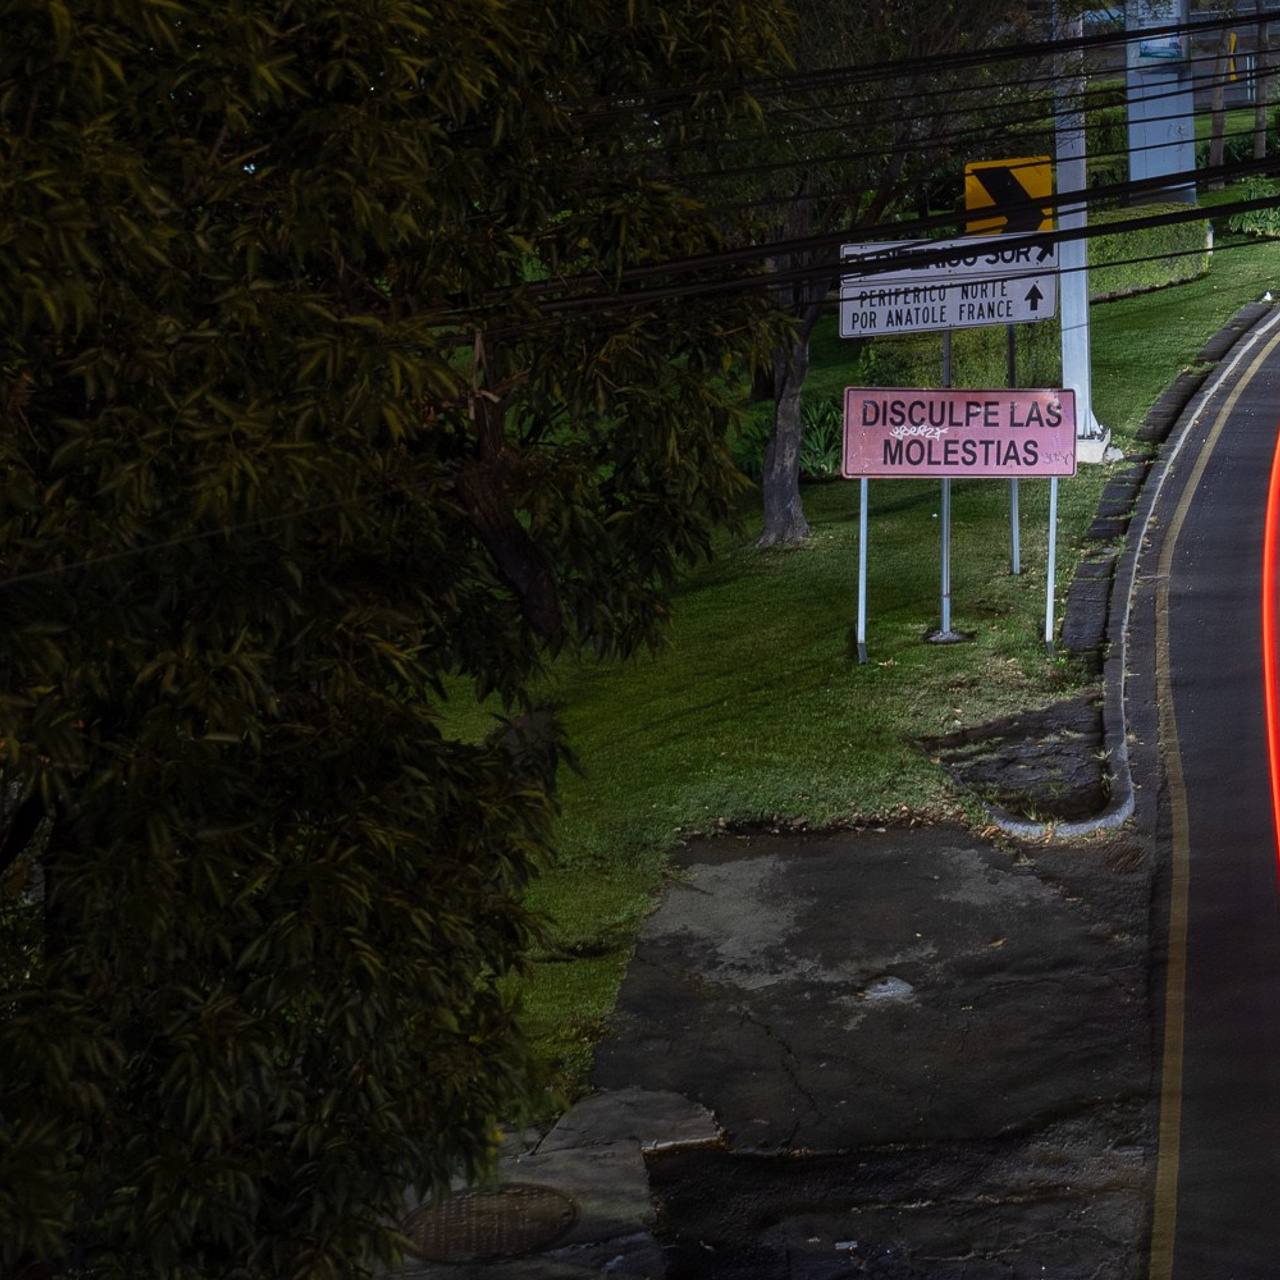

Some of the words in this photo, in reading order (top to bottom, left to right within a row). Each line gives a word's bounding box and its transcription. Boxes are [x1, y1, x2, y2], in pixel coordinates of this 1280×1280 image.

[859, 284, 946, 308] PERIFERICO
[961, 280, 1008, 300] NORTE
[852, 311, 877, 330] POR
[886, 306, 947, 327] ANATOLE
[959, 300, 1013, 320] FRANCE
[862, 400, 1000, 427] DISCULPE
[1009, 400, 1063, 427] LAS
[883, 439, 1039, 466] MOLESTIAS
